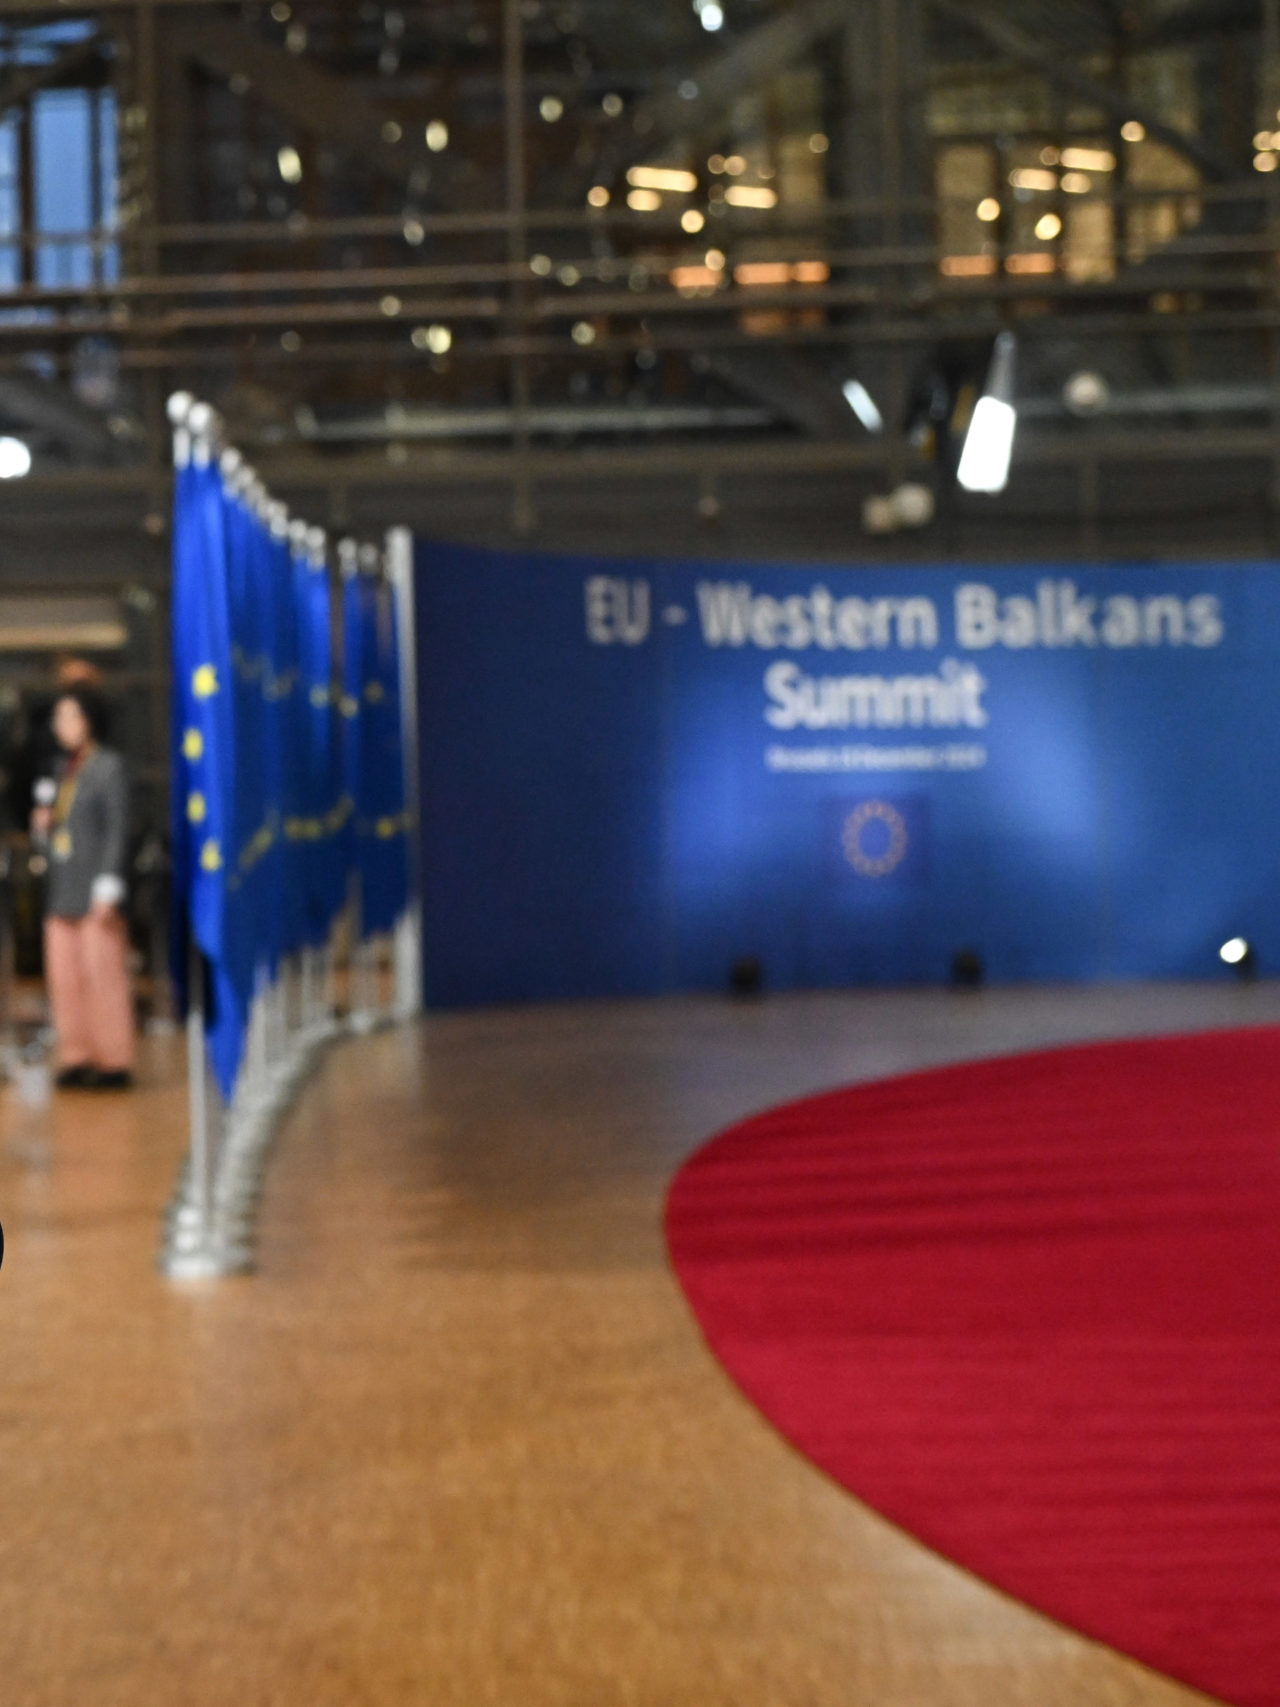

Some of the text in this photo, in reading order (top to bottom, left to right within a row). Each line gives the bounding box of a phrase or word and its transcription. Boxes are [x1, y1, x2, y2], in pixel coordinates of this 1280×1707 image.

[586, 576, 650, 646] EU
[696, 580, 939, 650] Western
[954, 577, 1224, 650] Balkans
[764, 657, 988, 730] Summit
